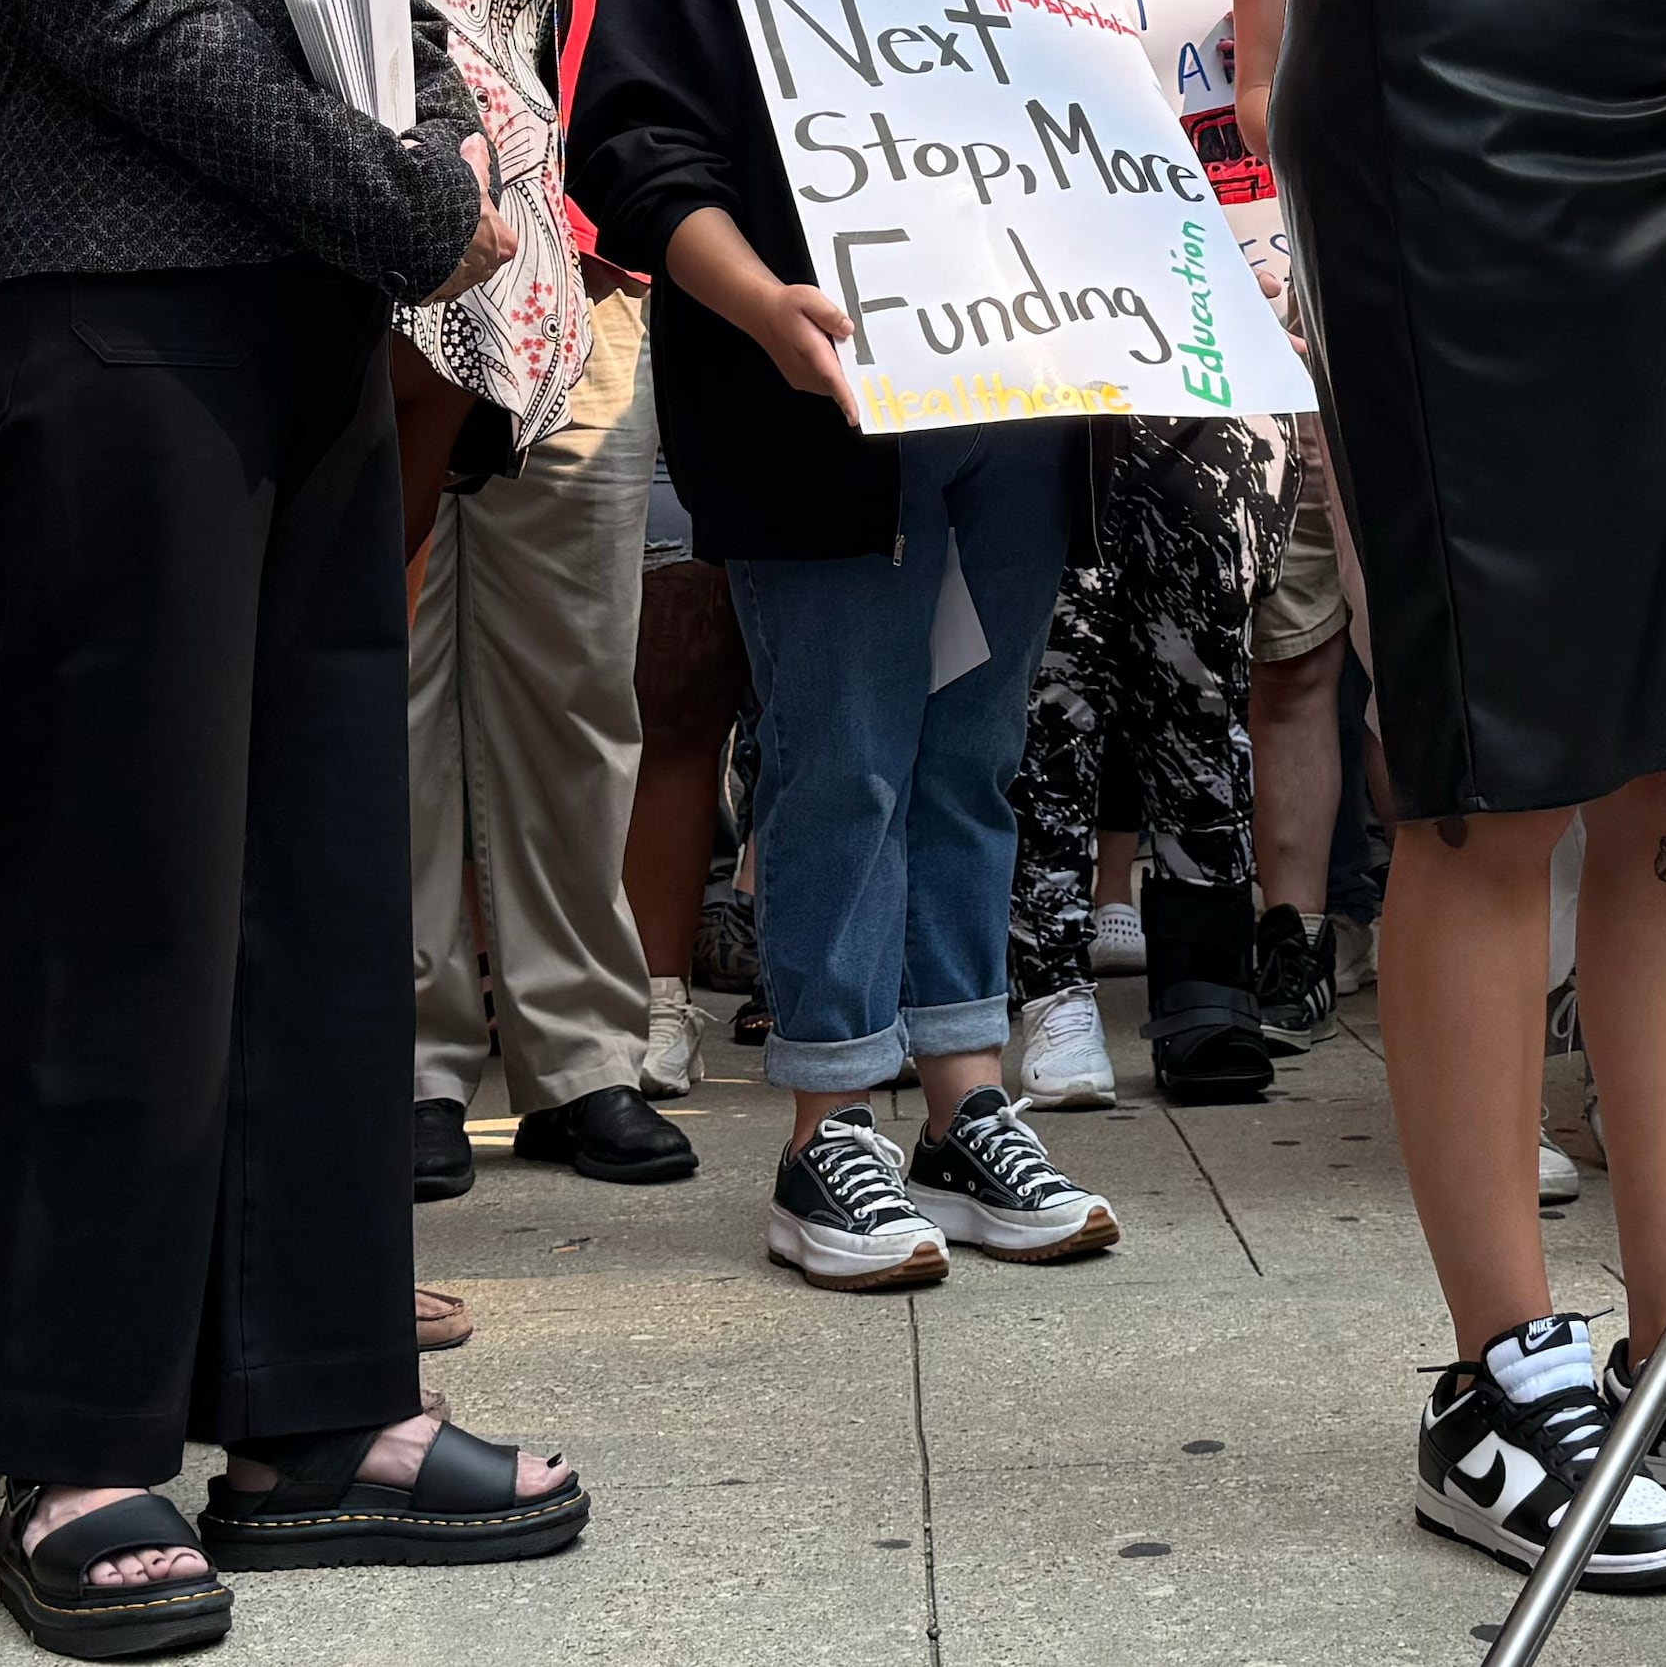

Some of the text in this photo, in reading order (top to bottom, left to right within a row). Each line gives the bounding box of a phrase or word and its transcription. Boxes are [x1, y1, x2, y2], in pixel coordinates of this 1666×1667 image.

[794, 97, 1205, 206] Stop, More
[833, 226, 1174, 366] Funding
[1171, 220, 1233, 410] Education
[860, 371, 1134, 429] Healthcare
[1528, 1318, 1555, 1337] NIKE
